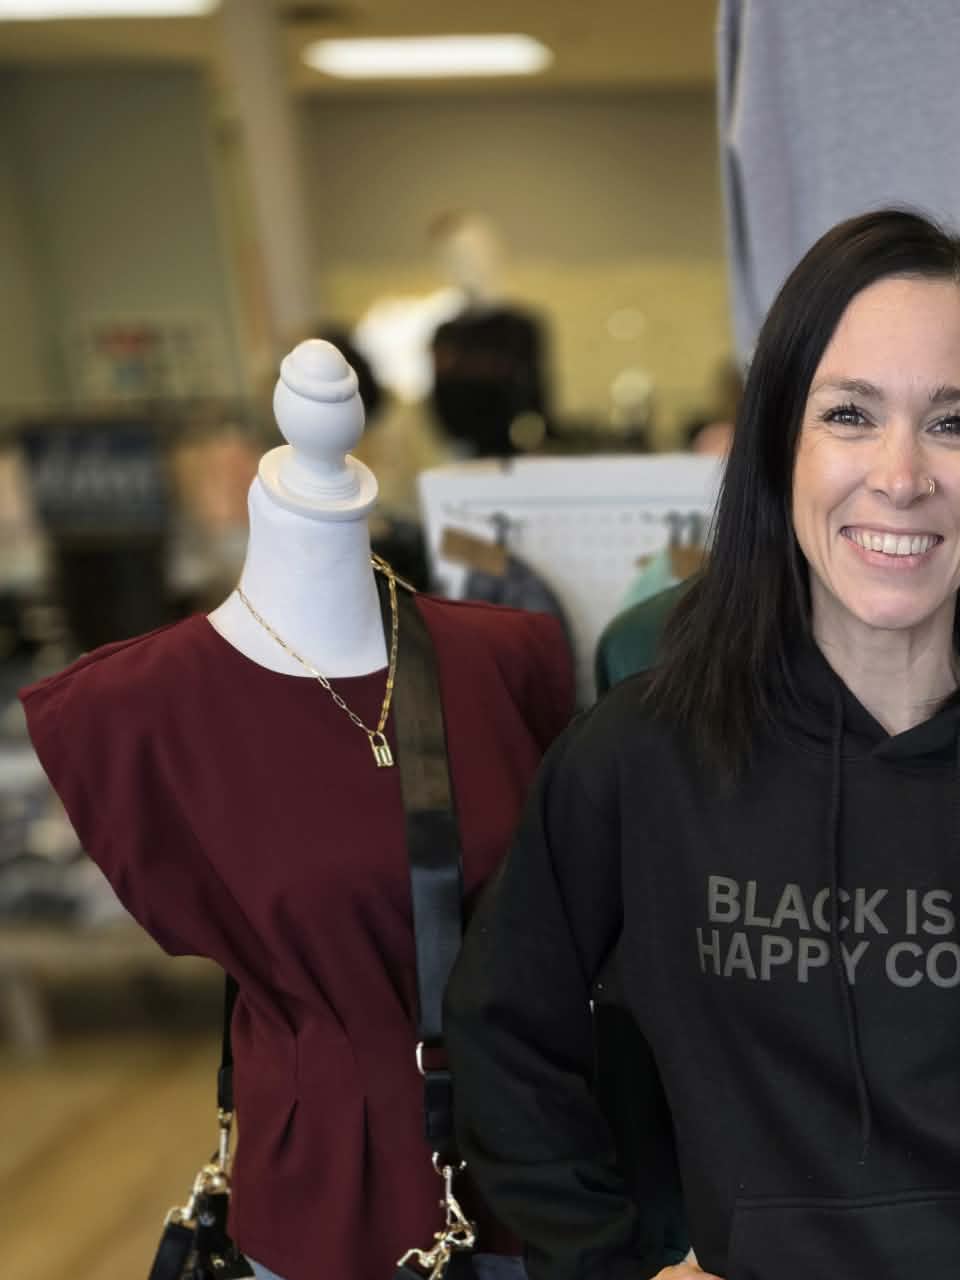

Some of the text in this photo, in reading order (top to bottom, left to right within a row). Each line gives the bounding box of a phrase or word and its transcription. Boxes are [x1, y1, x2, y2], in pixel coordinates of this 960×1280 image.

[707, 875, 889, 934] BLACK
[906, 888, 956, 935] IS
[696, 927, 870, 985] HAPPY
